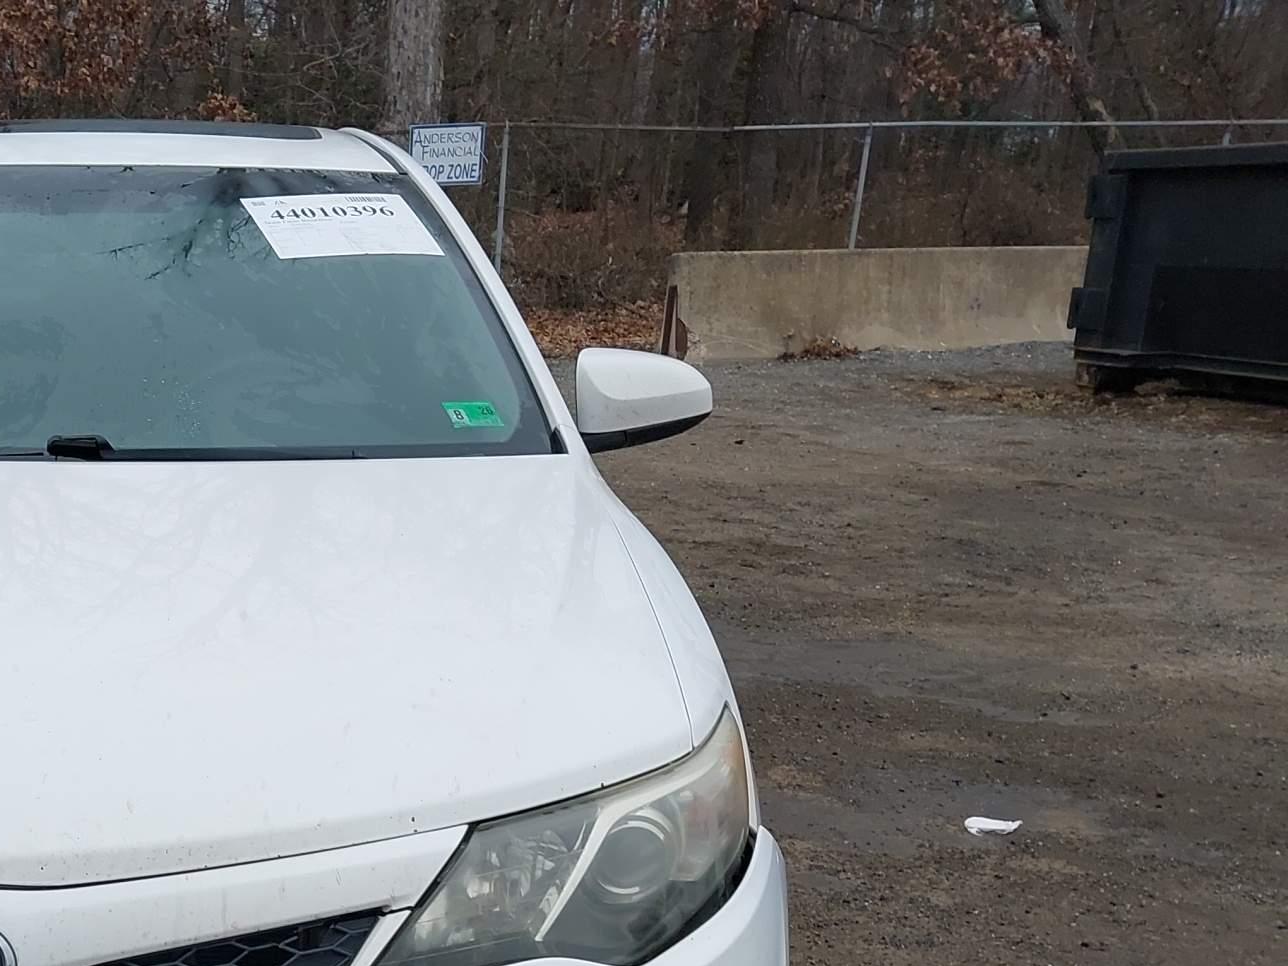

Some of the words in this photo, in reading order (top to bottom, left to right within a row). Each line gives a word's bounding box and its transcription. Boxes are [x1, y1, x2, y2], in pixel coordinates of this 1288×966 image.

[414, 130, 479, 145] ANDERSON
[421, 145, 479, 161] FINANCIAL
[447, 163, 478, 179] ZONE
[270, 204, 395, 220] 44010396
